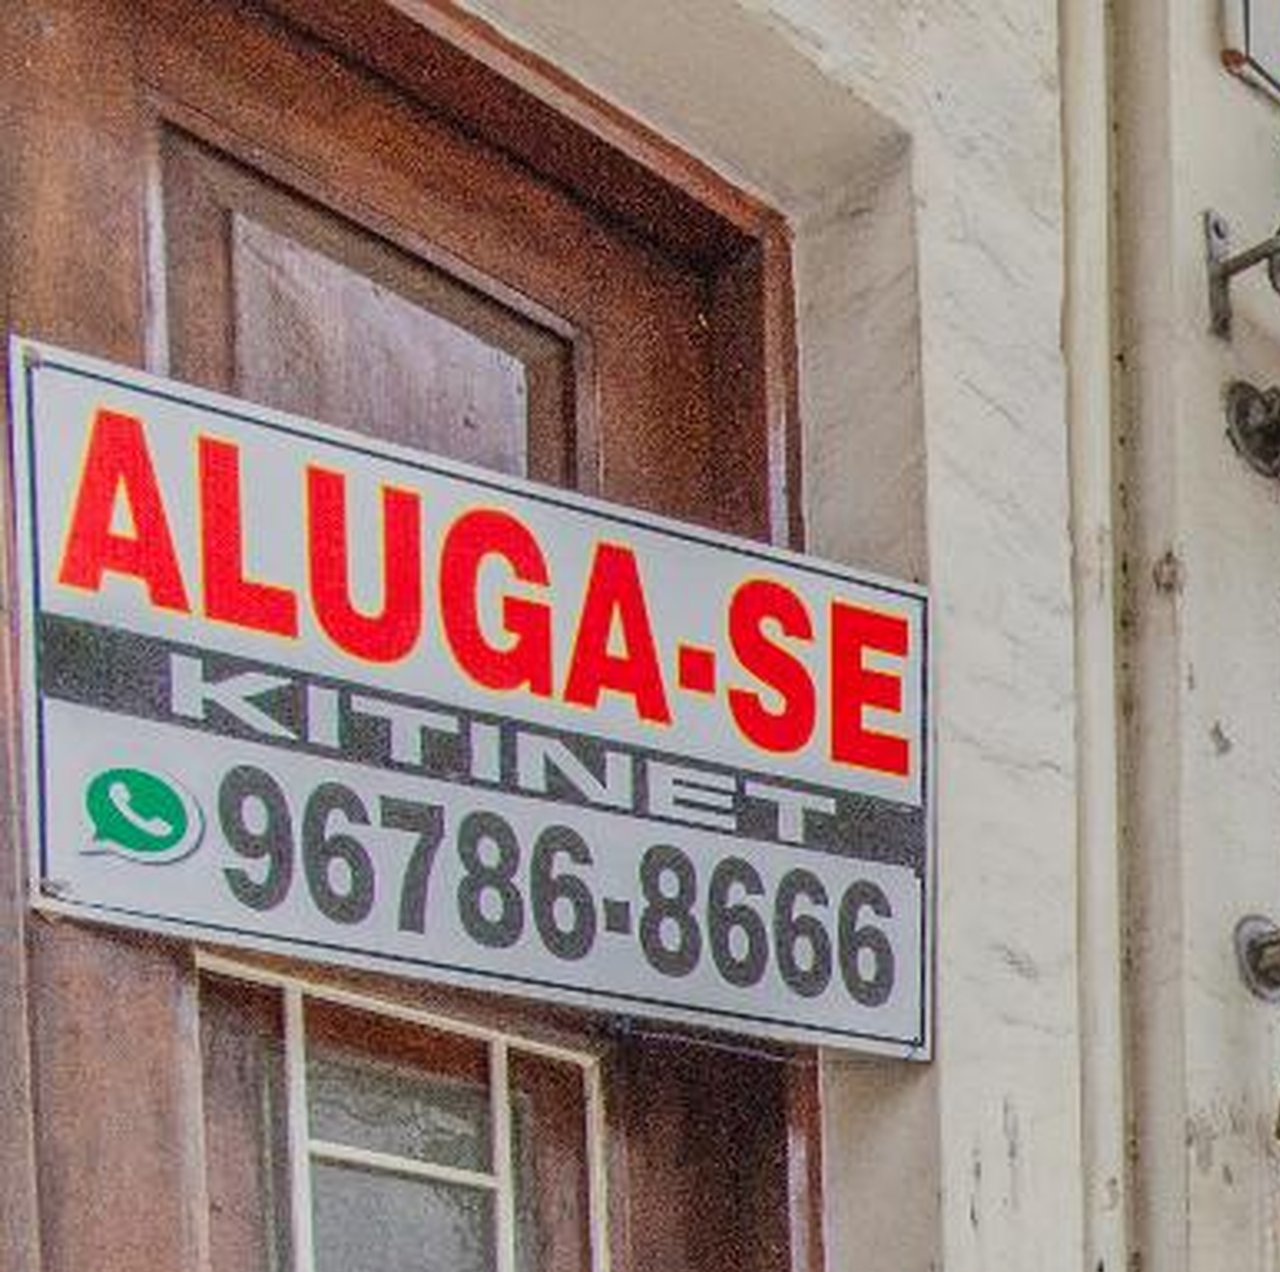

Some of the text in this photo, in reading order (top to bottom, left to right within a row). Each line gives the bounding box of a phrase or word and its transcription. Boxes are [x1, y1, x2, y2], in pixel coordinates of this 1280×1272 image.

[58, 405, 911, 777] ALUGA-SE
[170, 652, 836, 844] KITINET
[217, 764, 897, 1008] 96786-8666
